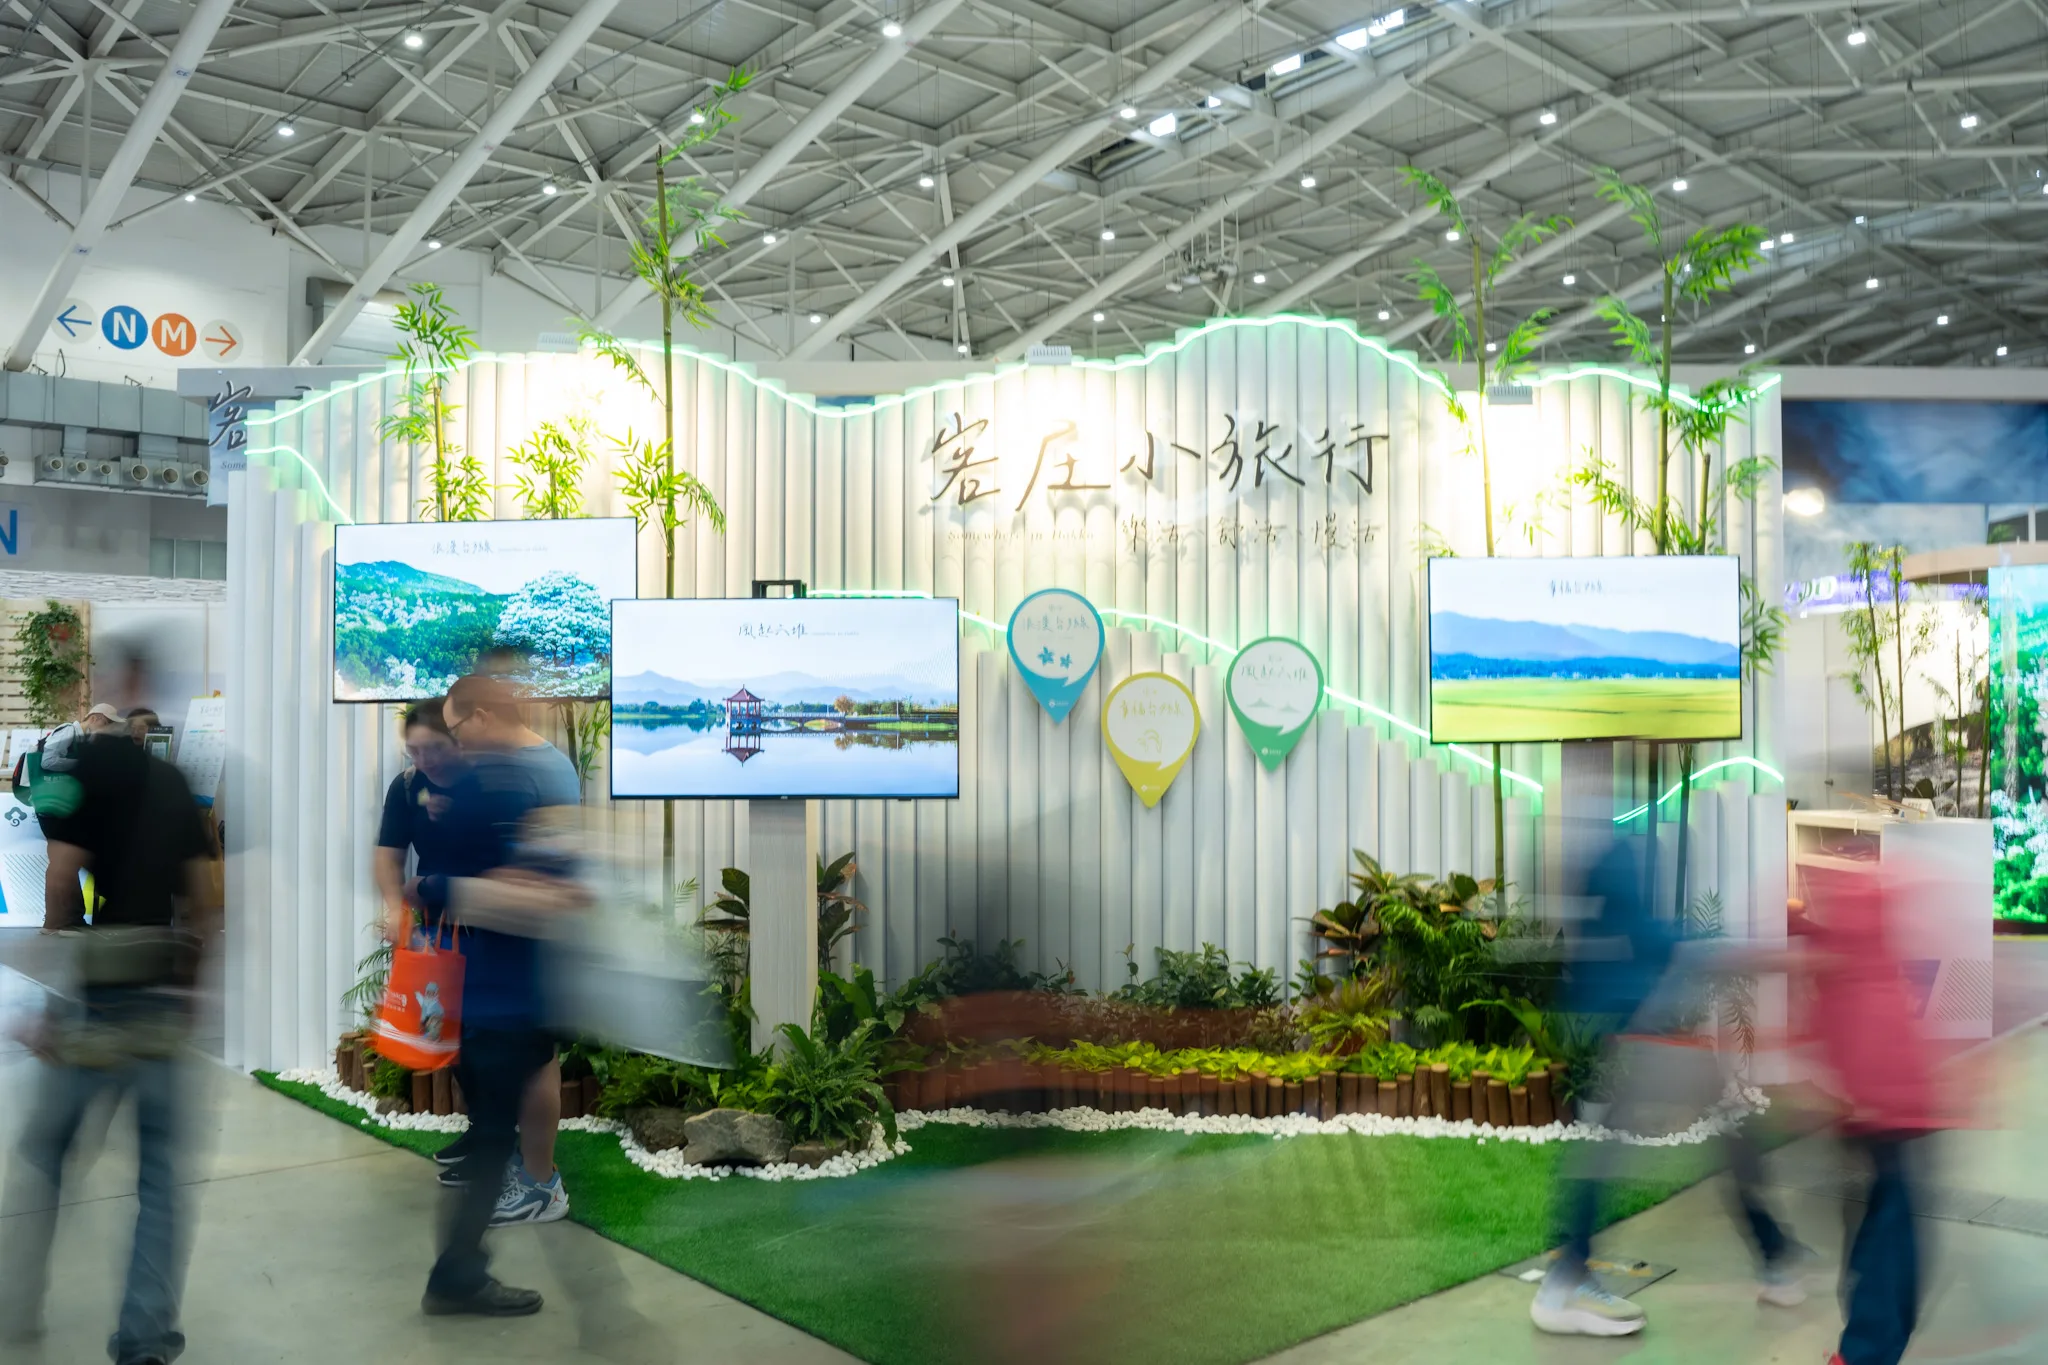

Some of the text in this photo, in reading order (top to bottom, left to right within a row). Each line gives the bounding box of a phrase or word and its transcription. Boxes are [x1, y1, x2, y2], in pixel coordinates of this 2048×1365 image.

[113, 311, 187, 351] N M
[931, 412, 1390, 512] 客庄小旅行
